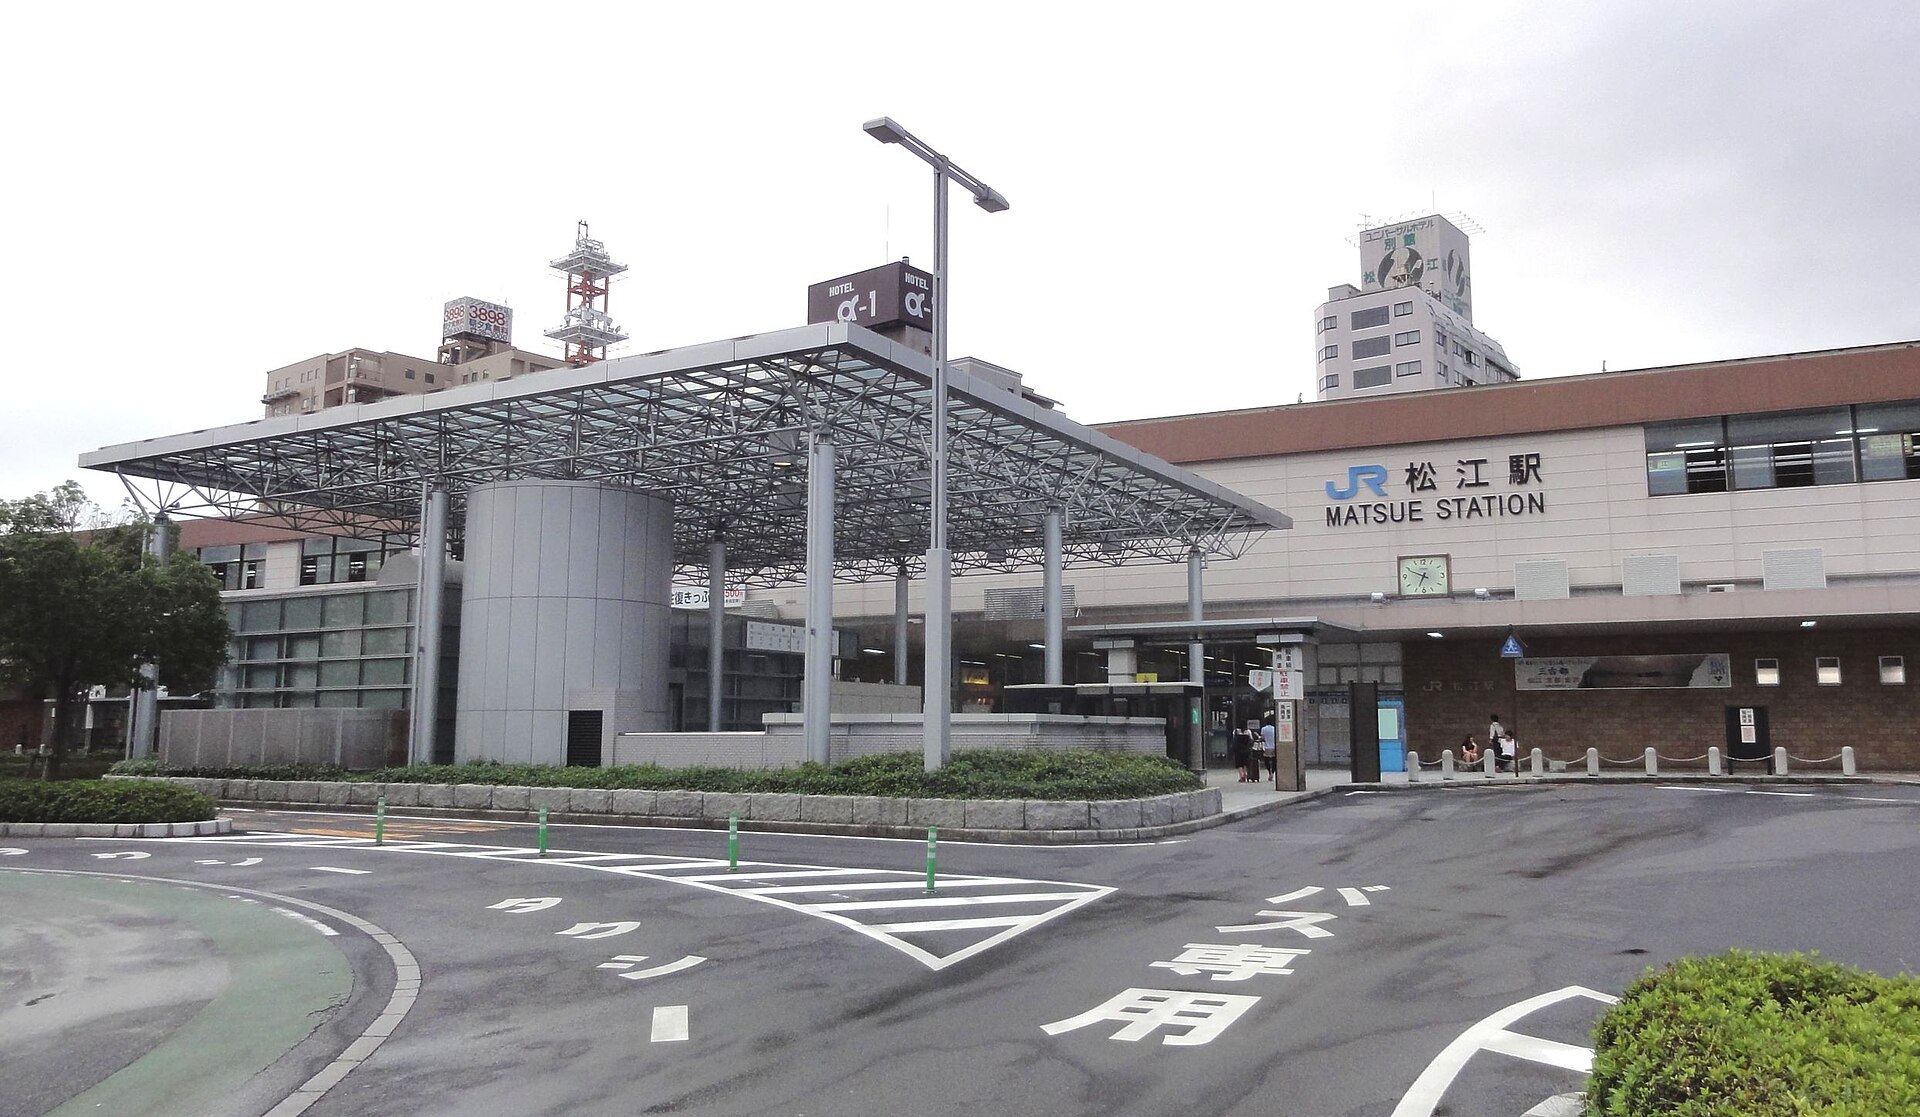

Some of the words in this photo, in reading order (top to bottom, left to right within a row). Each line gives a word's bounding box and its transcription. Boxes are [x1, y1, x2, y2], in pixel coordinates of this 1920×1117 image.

[829, 281, 855, 297] HOTEL
[904, 272, 929, 290] HOTEL
[469, 305, 506, 326] 3898
[1325, 464, 1389, 500] JR
[1405, 452, 1543, 494] 松江駅
[1325, 500, 1424, 527] MATSUE
[1436, 492, 1546, 520] STATION
[1039, 885, 1391, 1046] バス専用
